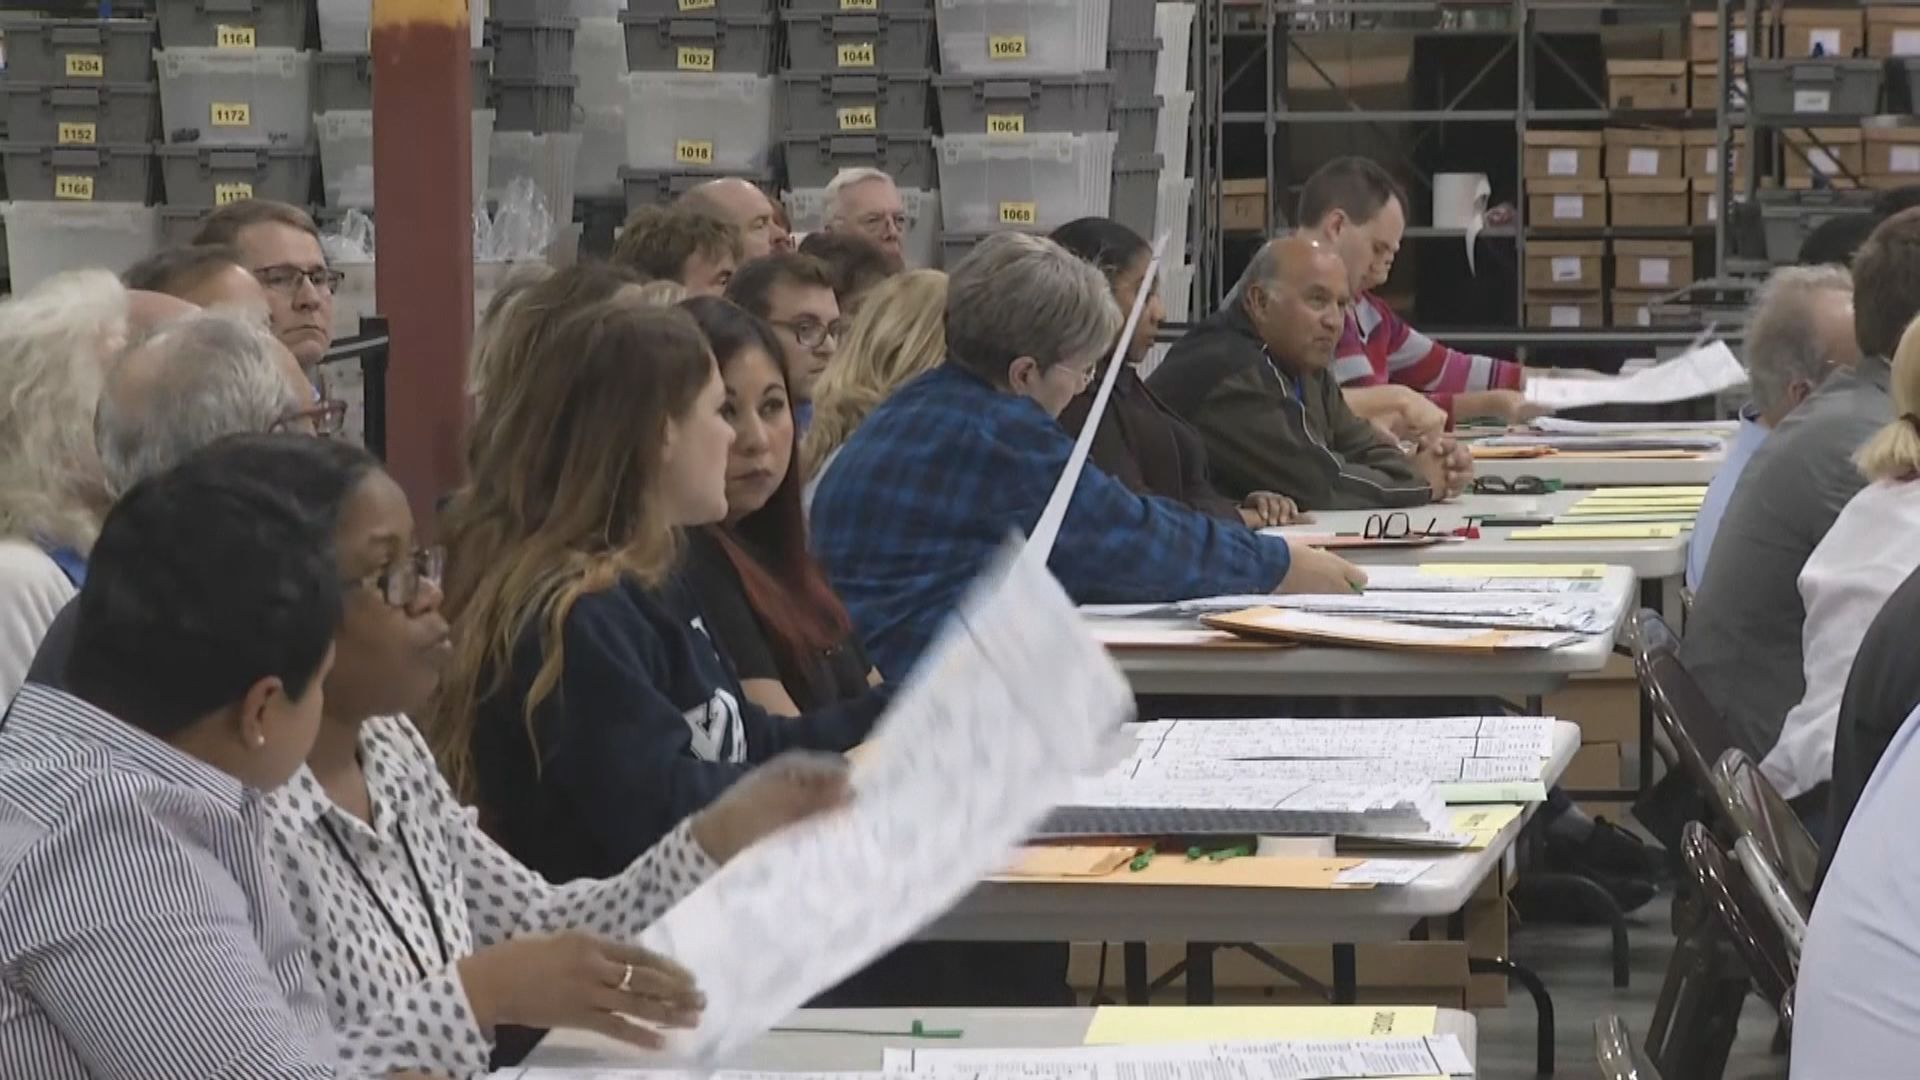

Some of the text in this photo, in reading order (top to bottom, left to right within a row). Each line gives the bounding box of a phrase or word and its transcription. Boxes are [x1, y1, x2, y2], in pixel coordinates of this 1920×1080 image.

[994, 41, 1022, 54] 1062
[683, 52, 711, 65] 1032
[843, 50, 871, 62] 1044
[71, 60, 99, 72] 1204
[217, 109, 246, 121] 1172
[844, 113, 873, 125] 1046
[992, 121, 1020, 132] 1064
[64, 129, 92, 140] 1152
